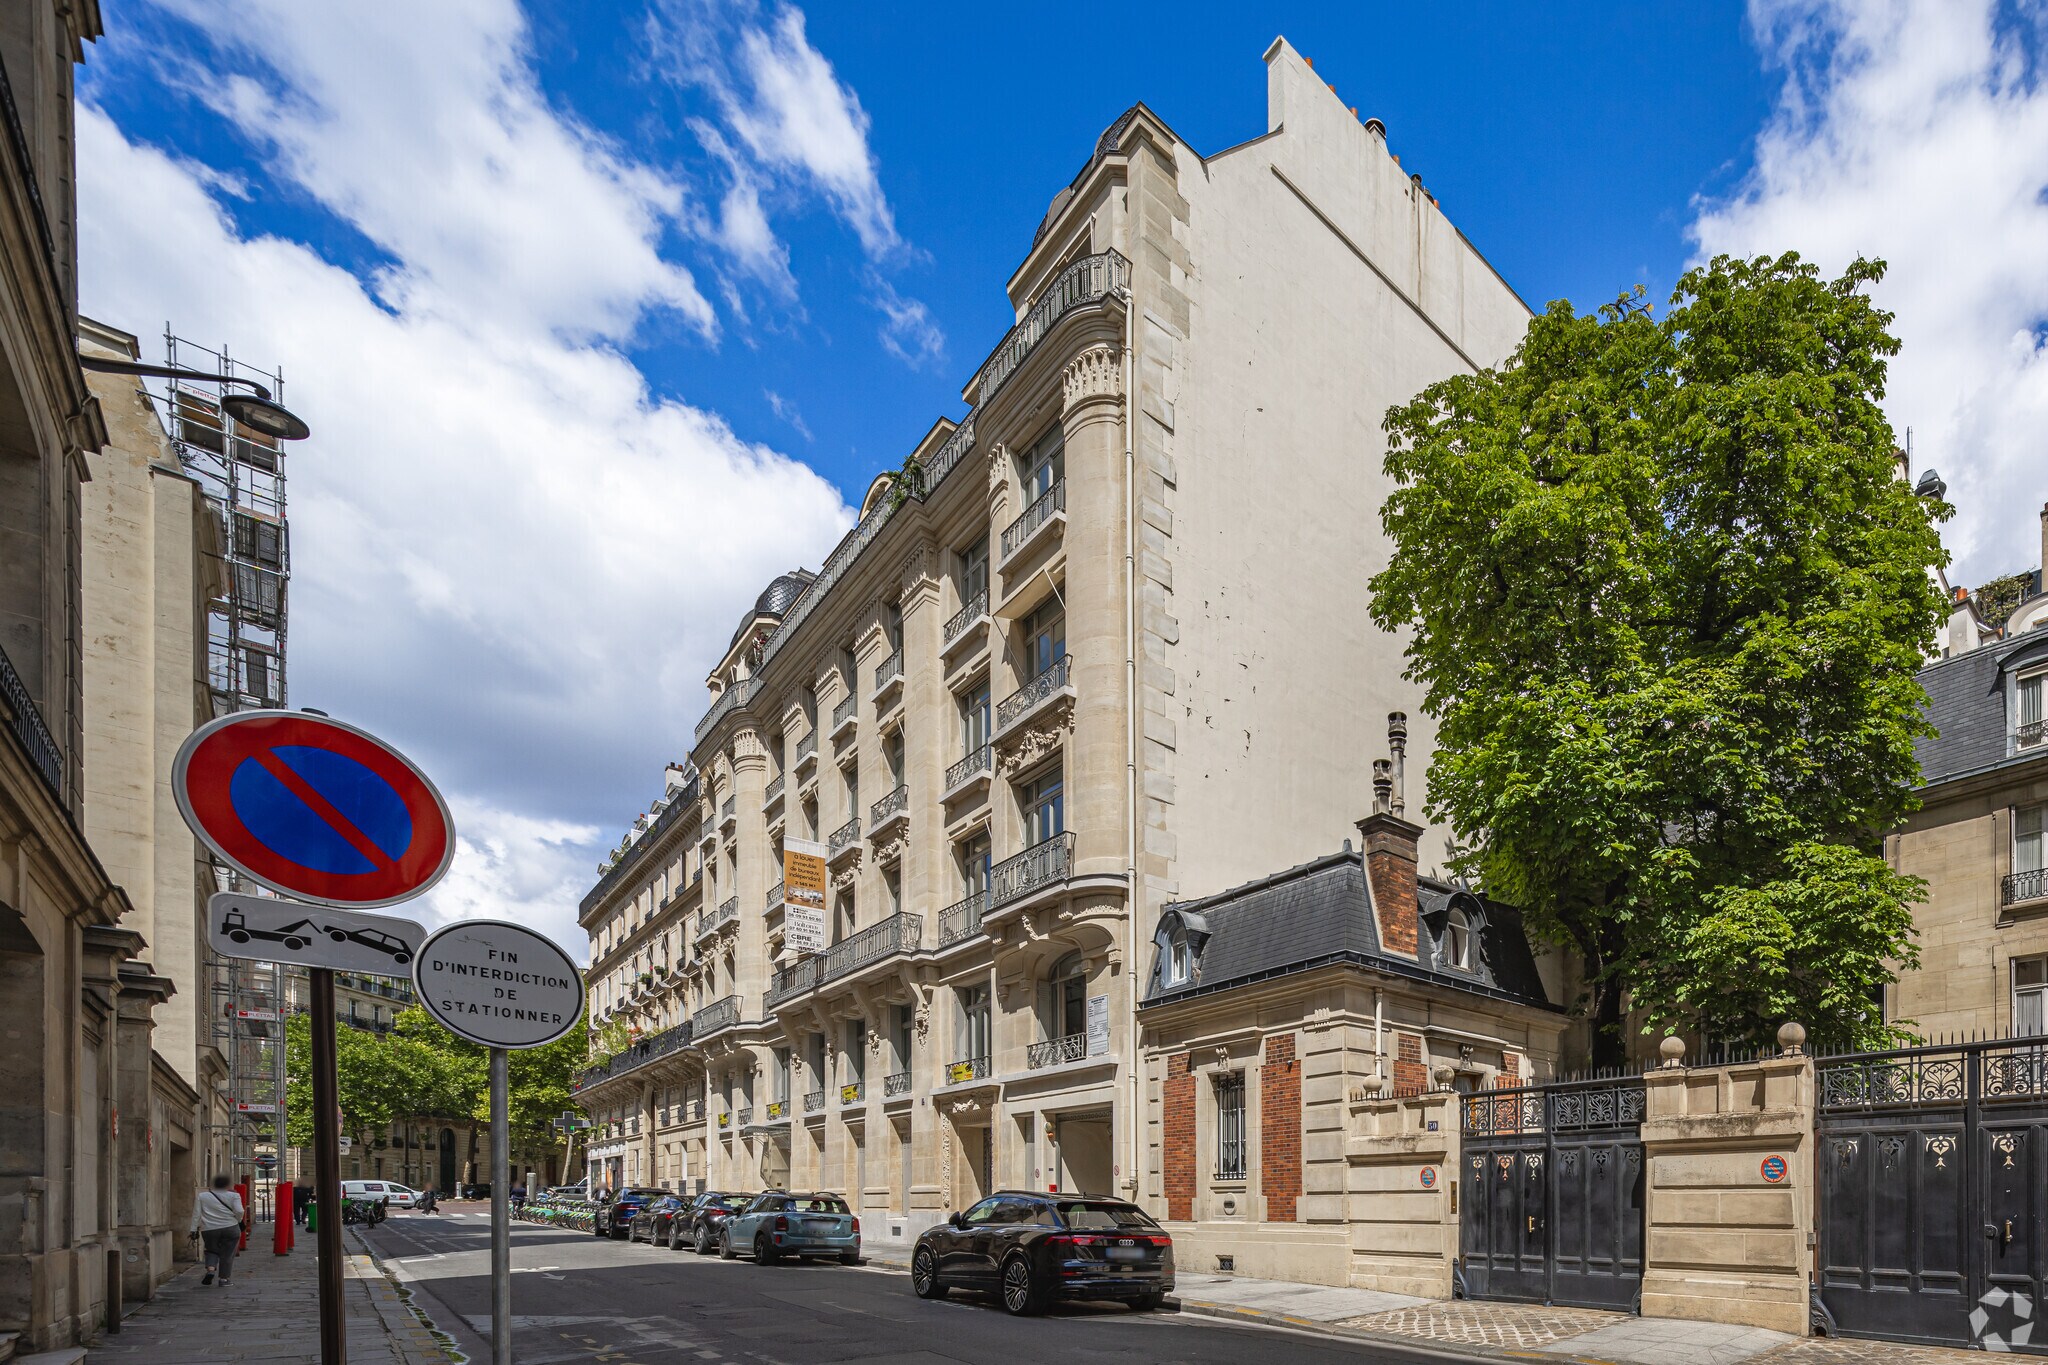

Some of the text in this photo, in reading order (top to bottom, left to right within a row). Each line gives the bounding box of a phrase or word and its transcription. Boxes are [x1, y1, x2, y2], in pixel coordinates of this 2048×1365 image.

[800, 854, 815, 862] louer
[792, 860, 817, 869] immeuble
[798, 867, 819, 876] bureaux
[789, 872, 821, 882] indépendant
[791, 933, 812, 941] CBRE
[488, 949, 518, 964] FIN
[433, 960, 569, 990] D'INTERDICTION
[494, 987, 517, 1001] DE
[442, 1000, 562, 1025] STATIONNER
